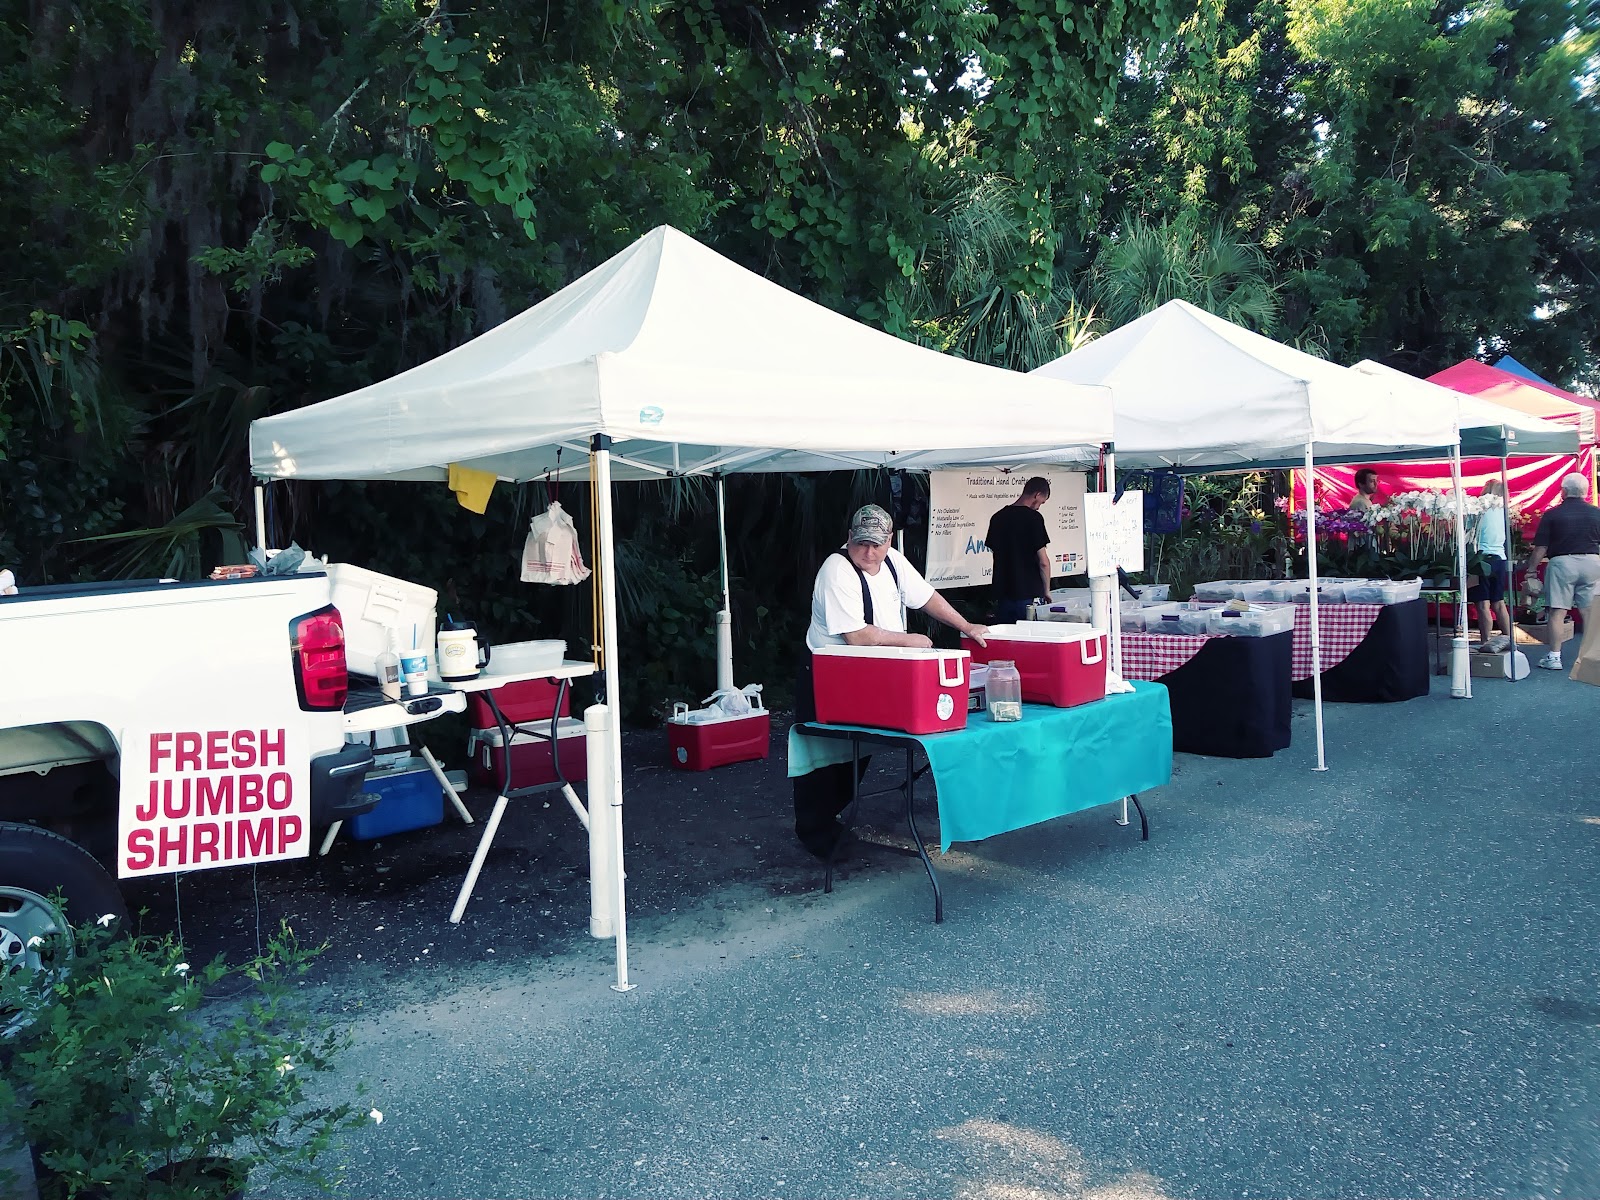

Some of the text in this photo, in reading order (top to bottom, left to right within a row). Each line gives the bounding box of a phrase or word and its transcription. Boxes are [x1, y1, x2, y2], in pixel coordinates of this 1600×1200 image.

[966, 477, 995, 486] Traditional
[996, 477, 1010, 486] Hand
[150, 729, 286, 773] FRESH
[136, 772, 293, 821] JUMBO
[127, 815, 302, 870] SHRIMP
